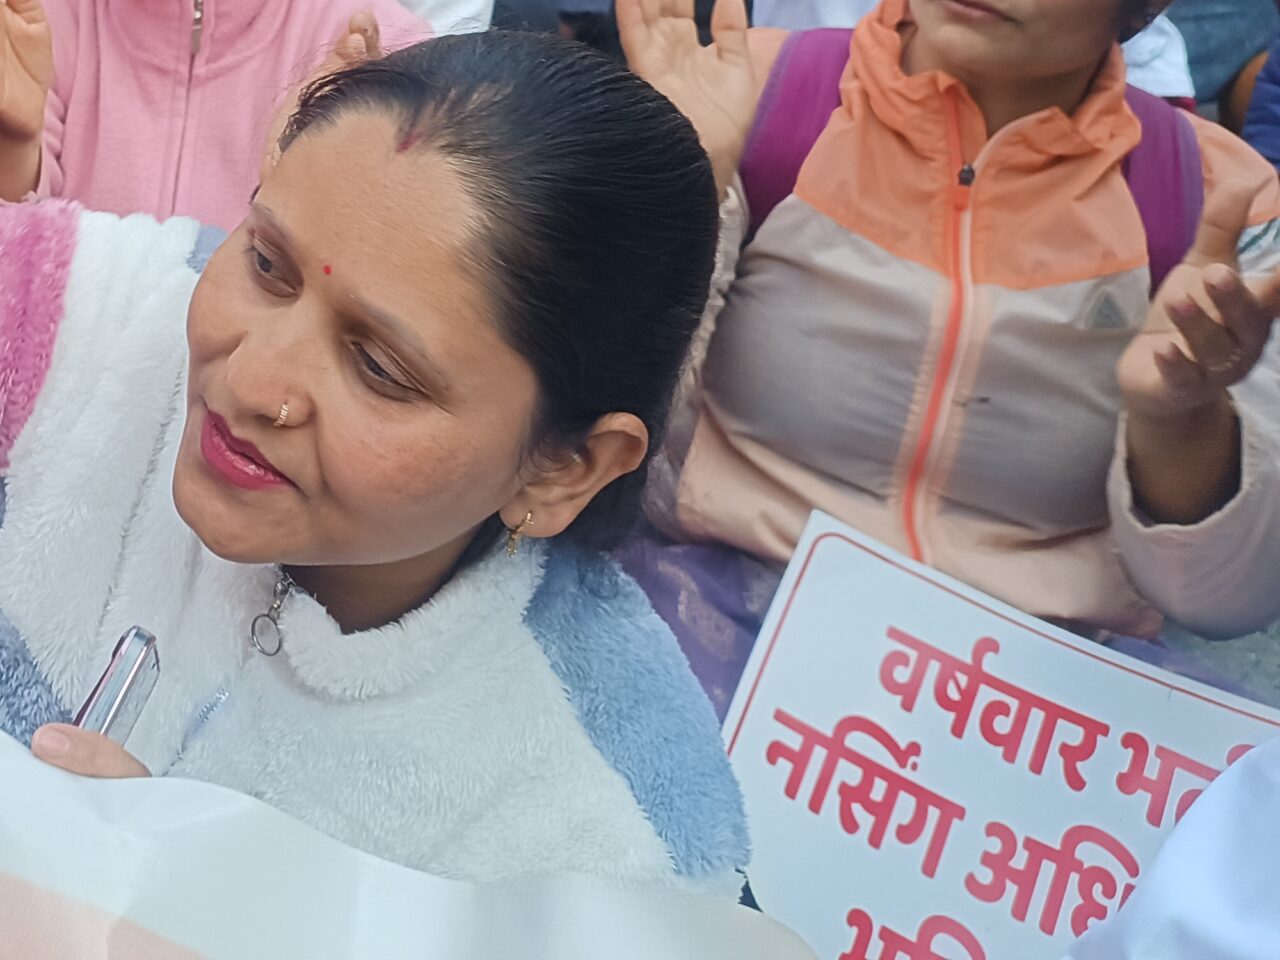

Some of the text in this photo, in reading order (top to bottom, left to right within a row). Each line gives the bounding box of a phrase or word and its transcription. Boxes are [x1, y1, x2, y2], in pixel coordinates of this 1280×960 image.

[878, 626, 1110, 792] वर्षवार
[765, 707, 1140, 939] नर्सिंग अधि
